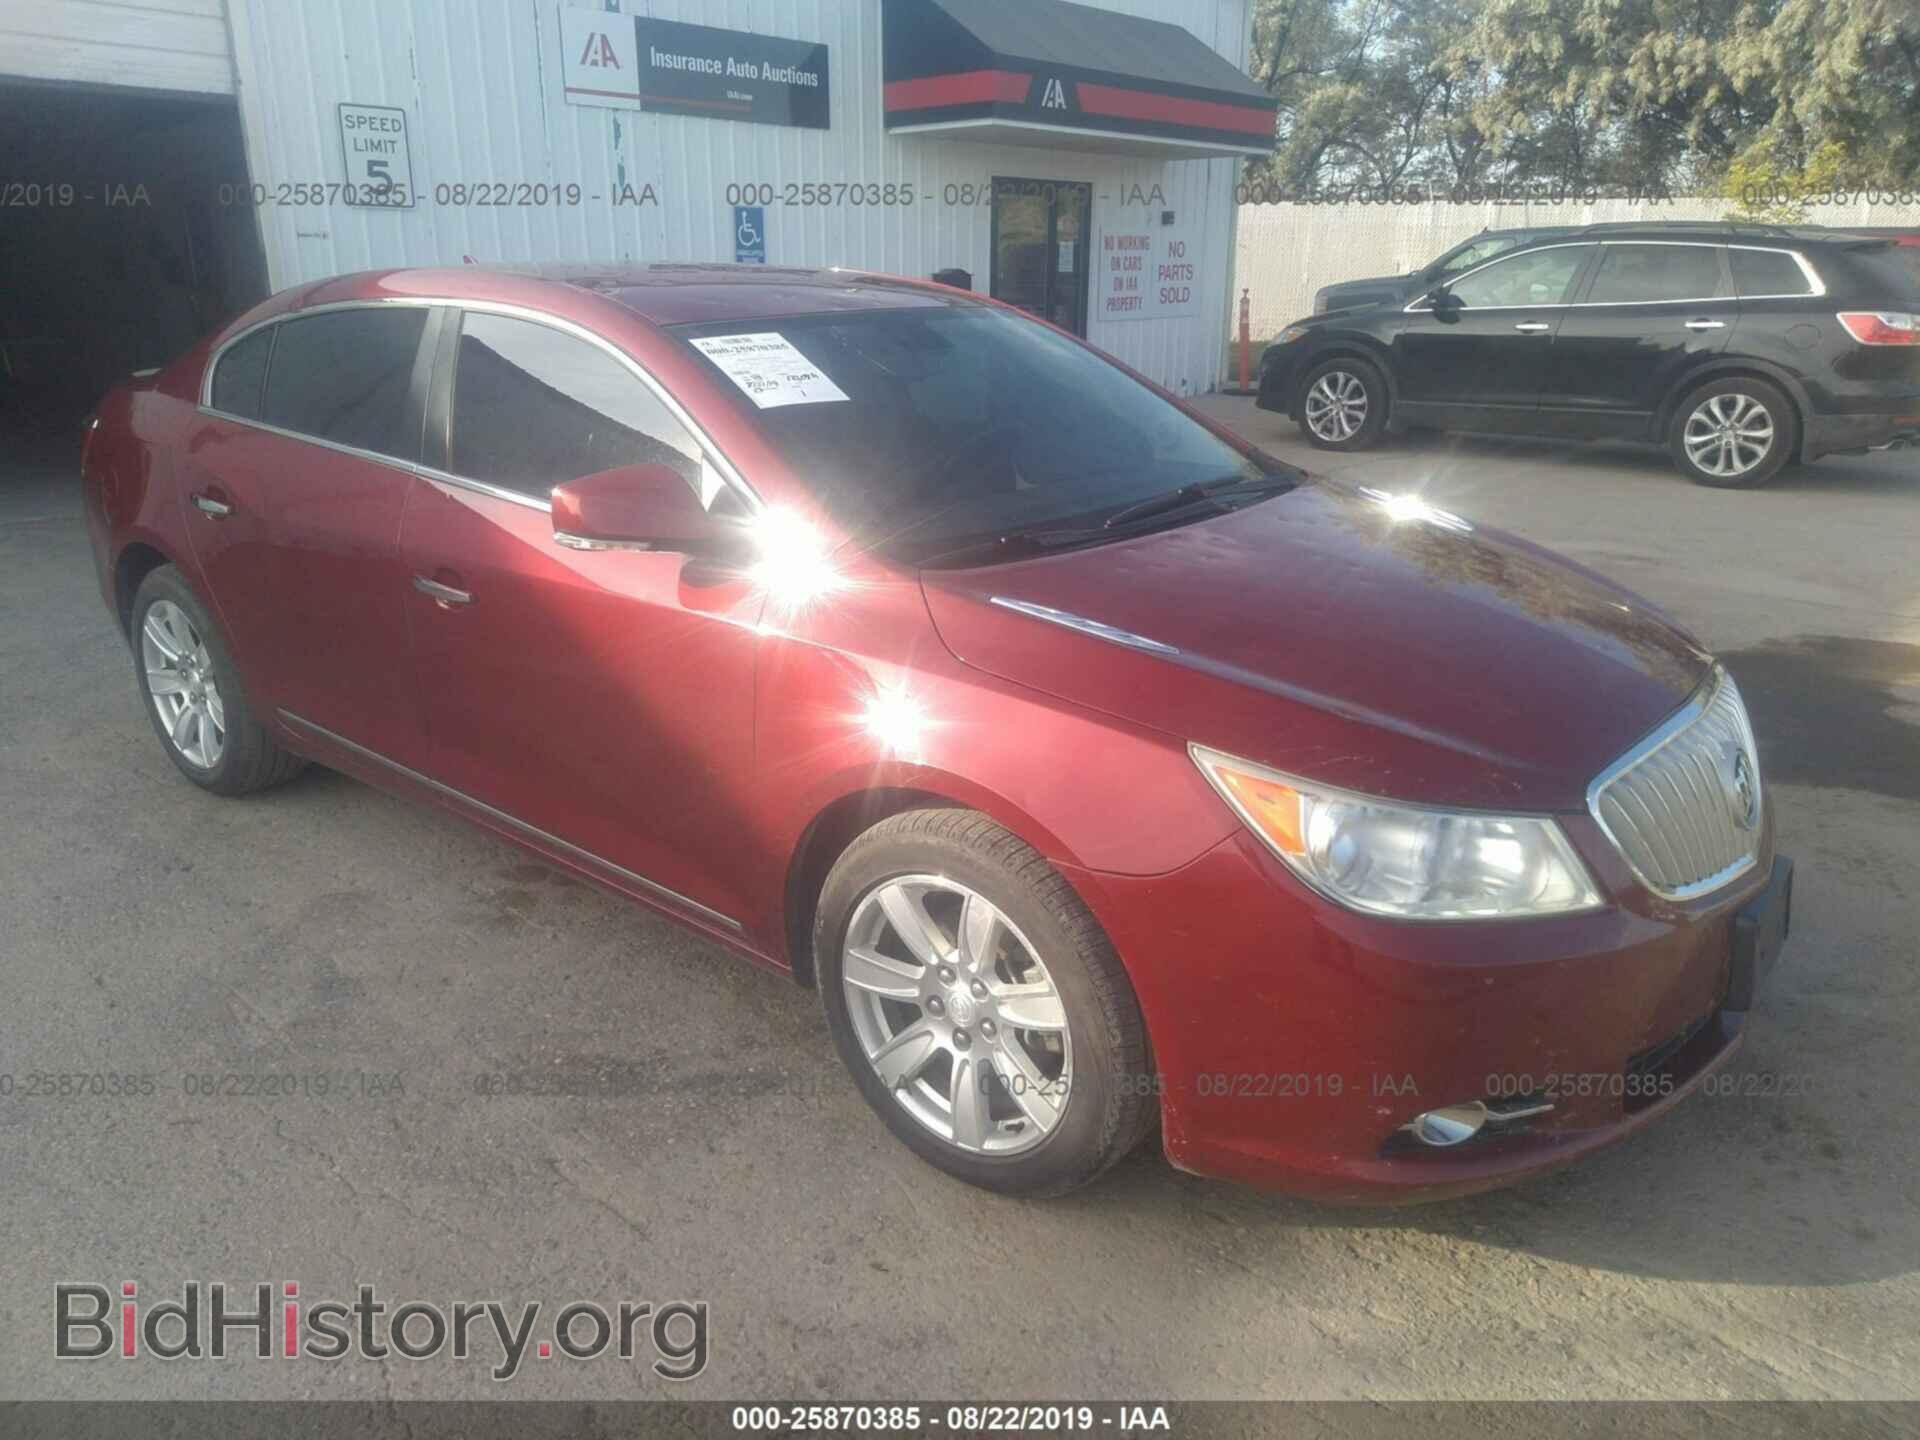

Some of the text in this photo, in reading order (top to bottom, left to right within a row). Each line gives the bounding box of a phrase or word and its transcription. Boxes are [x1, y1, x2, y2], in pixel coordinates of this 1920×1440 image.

[650, 46, 819, 88] Insurance Auto Auctions
[344, 114, 402, 133] SPEED
[353, 137, 398, 153] LIMIT
[366, 160, 393, 197] 5
[1168, 240, 1185, 258] NO
[1158, 264, 1193, 281] PARTS
[1159, 287, 1191, 304] SOLD
